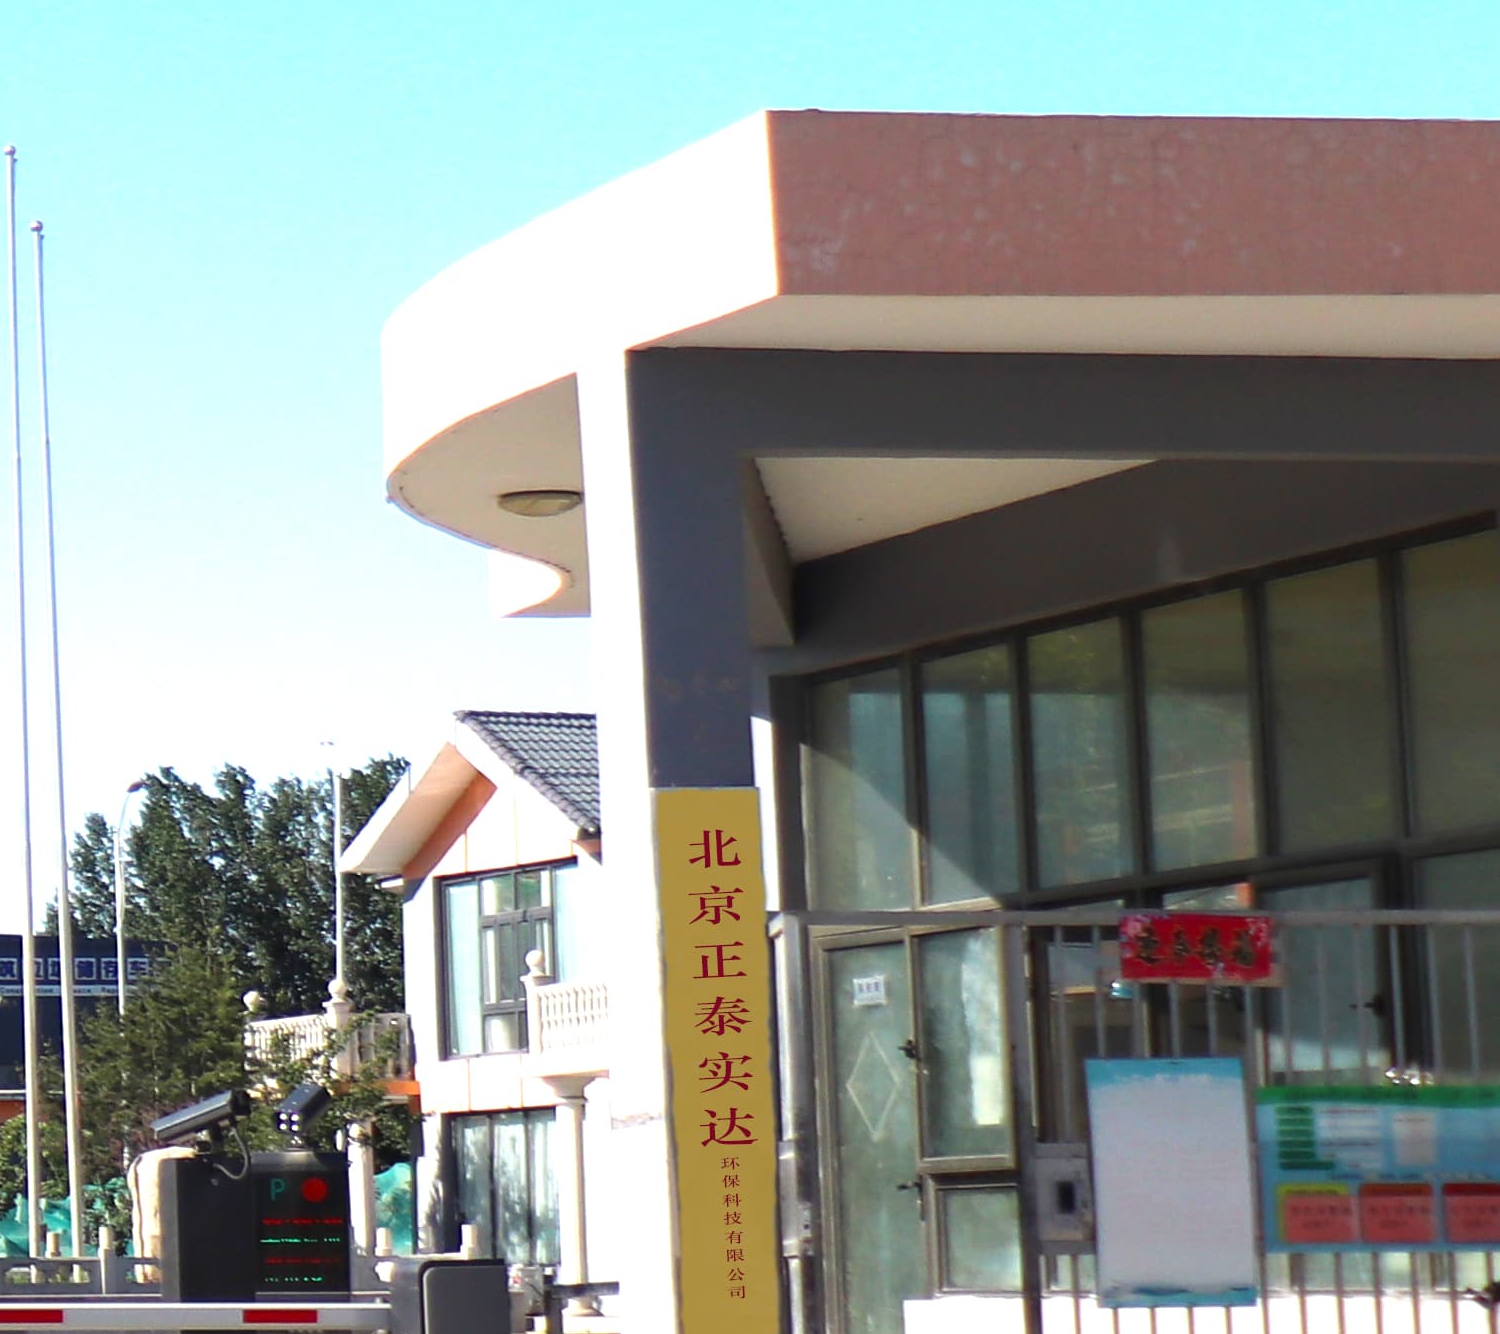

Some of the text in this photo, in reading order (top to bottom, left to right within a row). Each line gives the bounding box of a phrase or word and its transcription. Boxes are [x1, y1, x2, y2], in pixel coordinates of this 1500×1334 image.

[688, 829, 759, 1148] 北京正泰实达
[721, 1156, 746, 1300] 环保科技有限公司
